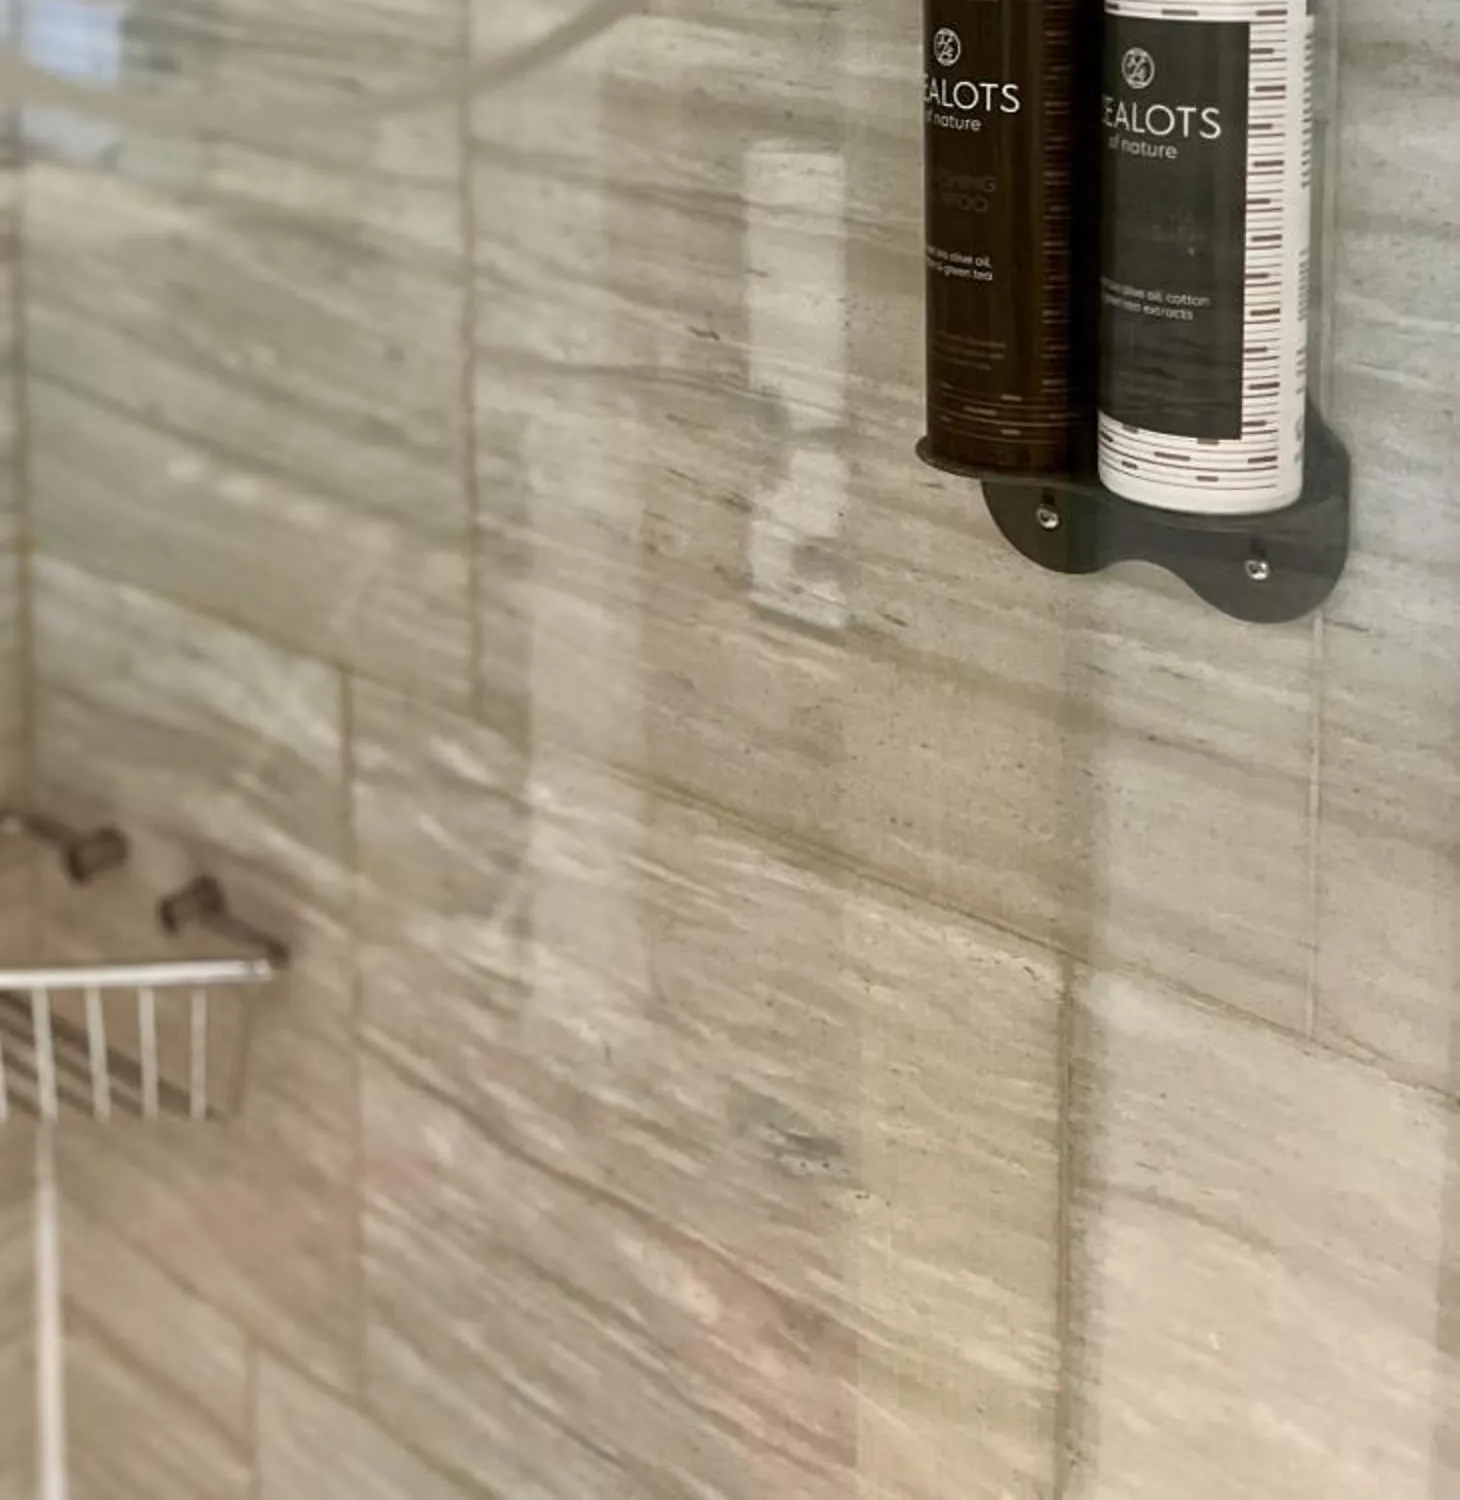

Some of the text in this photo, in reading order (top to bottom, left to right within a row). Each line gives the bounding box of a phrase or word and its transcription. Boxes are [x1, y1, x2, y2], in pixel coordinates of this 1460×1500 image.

[933, 112, 982, 132] nature
[1121, 139, 1179, 159] nature
[1165, 293, 1211, 308] cotton
